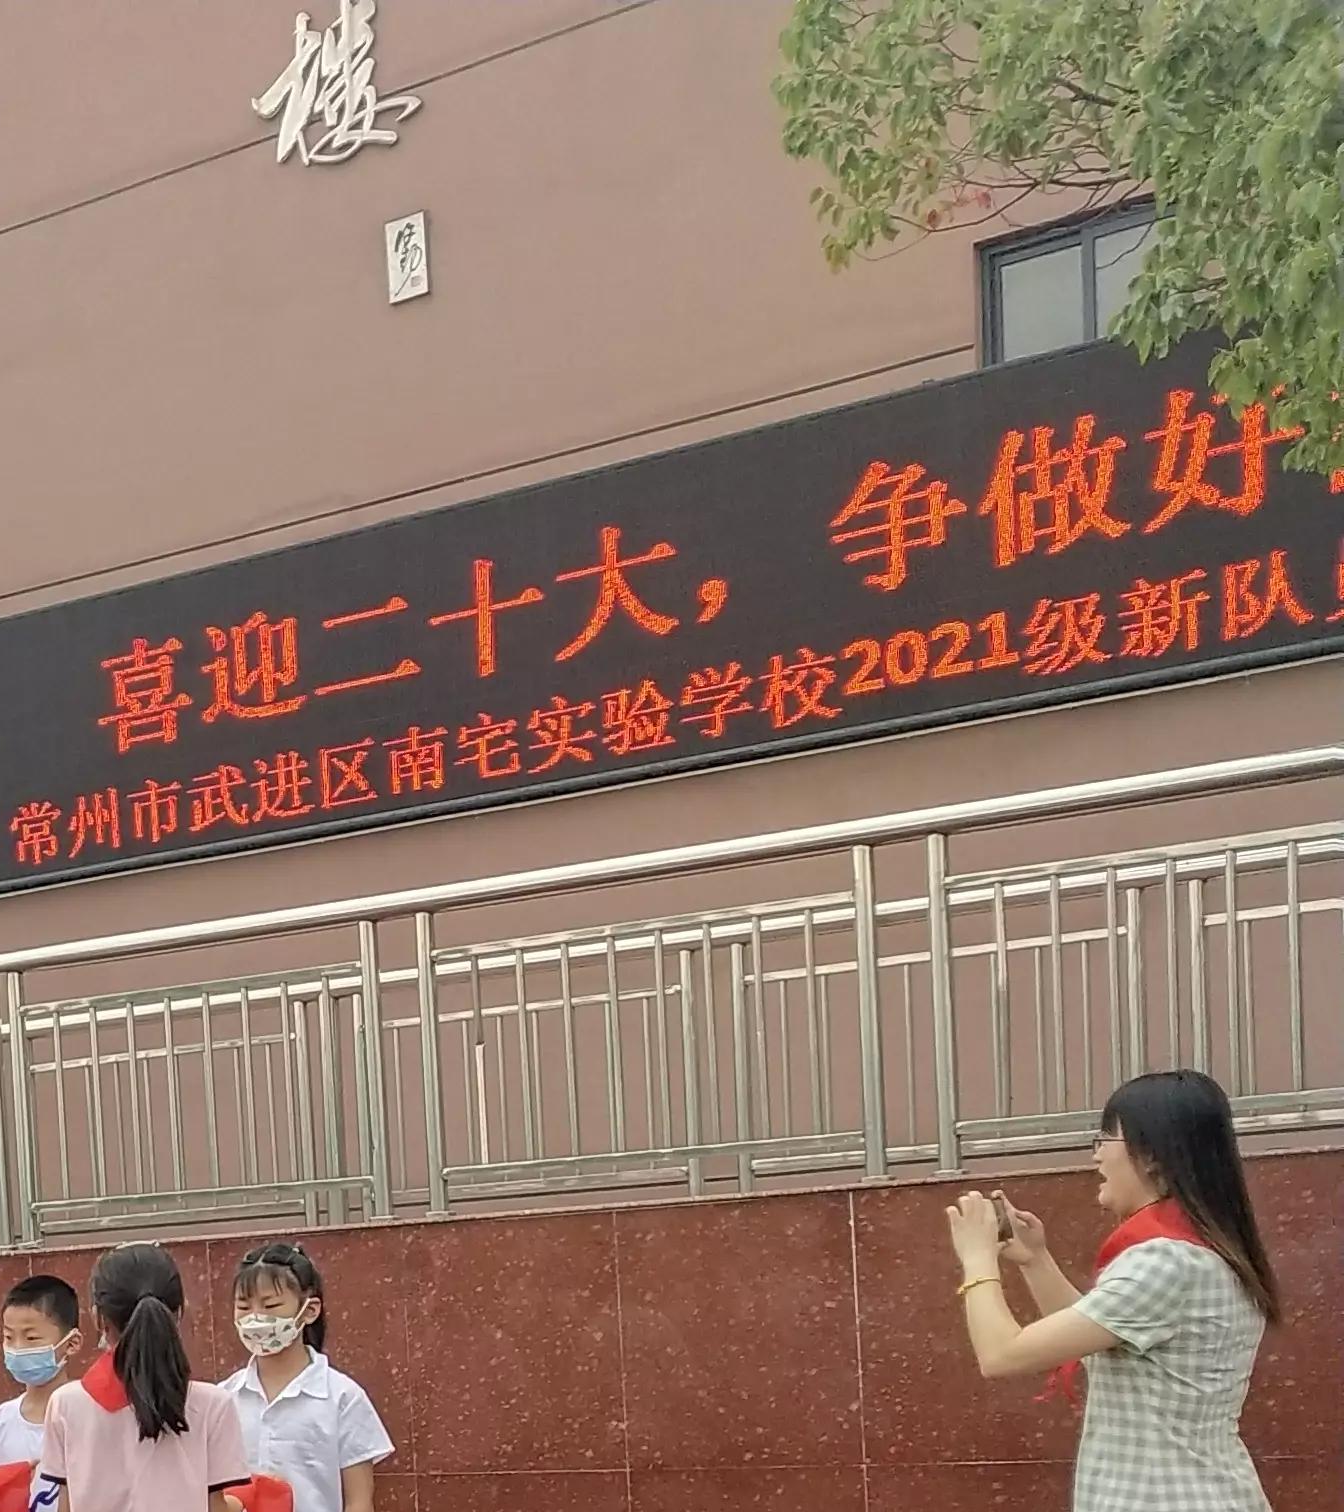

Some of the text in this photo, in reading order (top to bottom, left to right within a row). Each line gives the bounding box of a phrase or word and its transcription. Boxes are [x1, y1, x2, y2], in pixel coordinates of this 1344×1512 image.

[10, 540, 1344, 865] 常州市武进区南宅实验学校2021级新队
[97, 388, 1344, 753] 喜迎二十大，争做好
